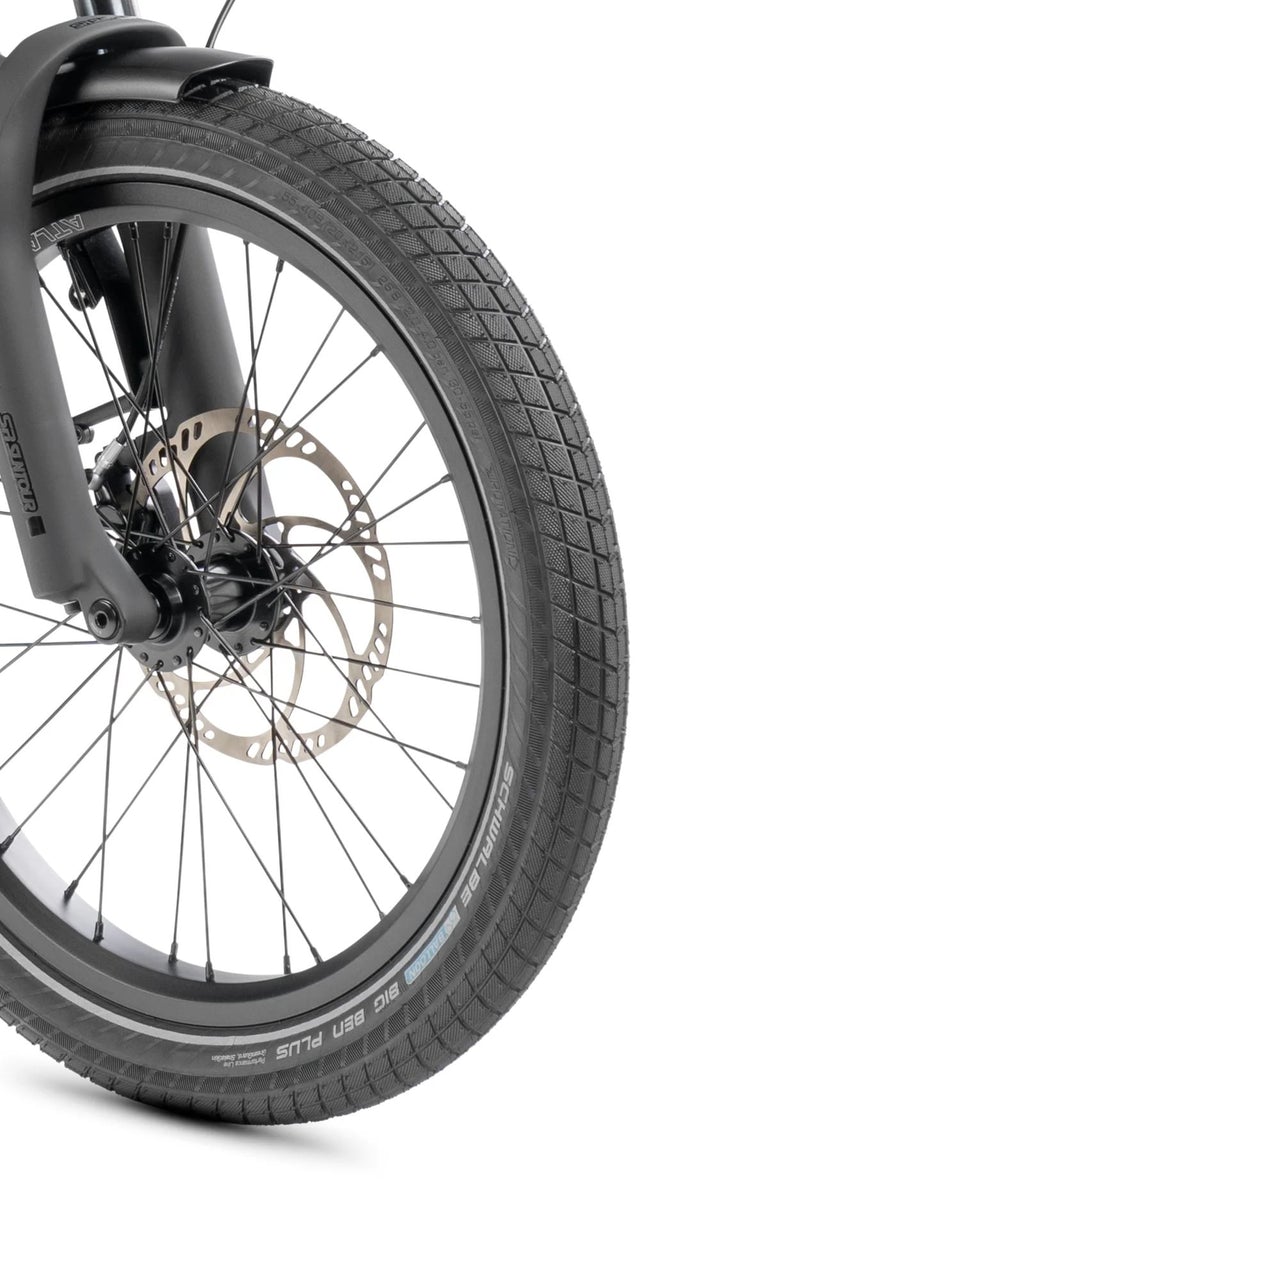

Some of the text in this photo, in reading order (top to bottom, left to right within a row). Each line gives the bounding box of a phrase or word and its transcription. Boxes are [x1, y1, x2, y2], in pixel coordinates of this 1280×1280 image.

[31, 214, 85, 252] ATLA
[460, 761, 514, 908] SCHWALBE
[374, 981, 400, 1013] BIG
[275, 1031, 323, 1060] PLUS
